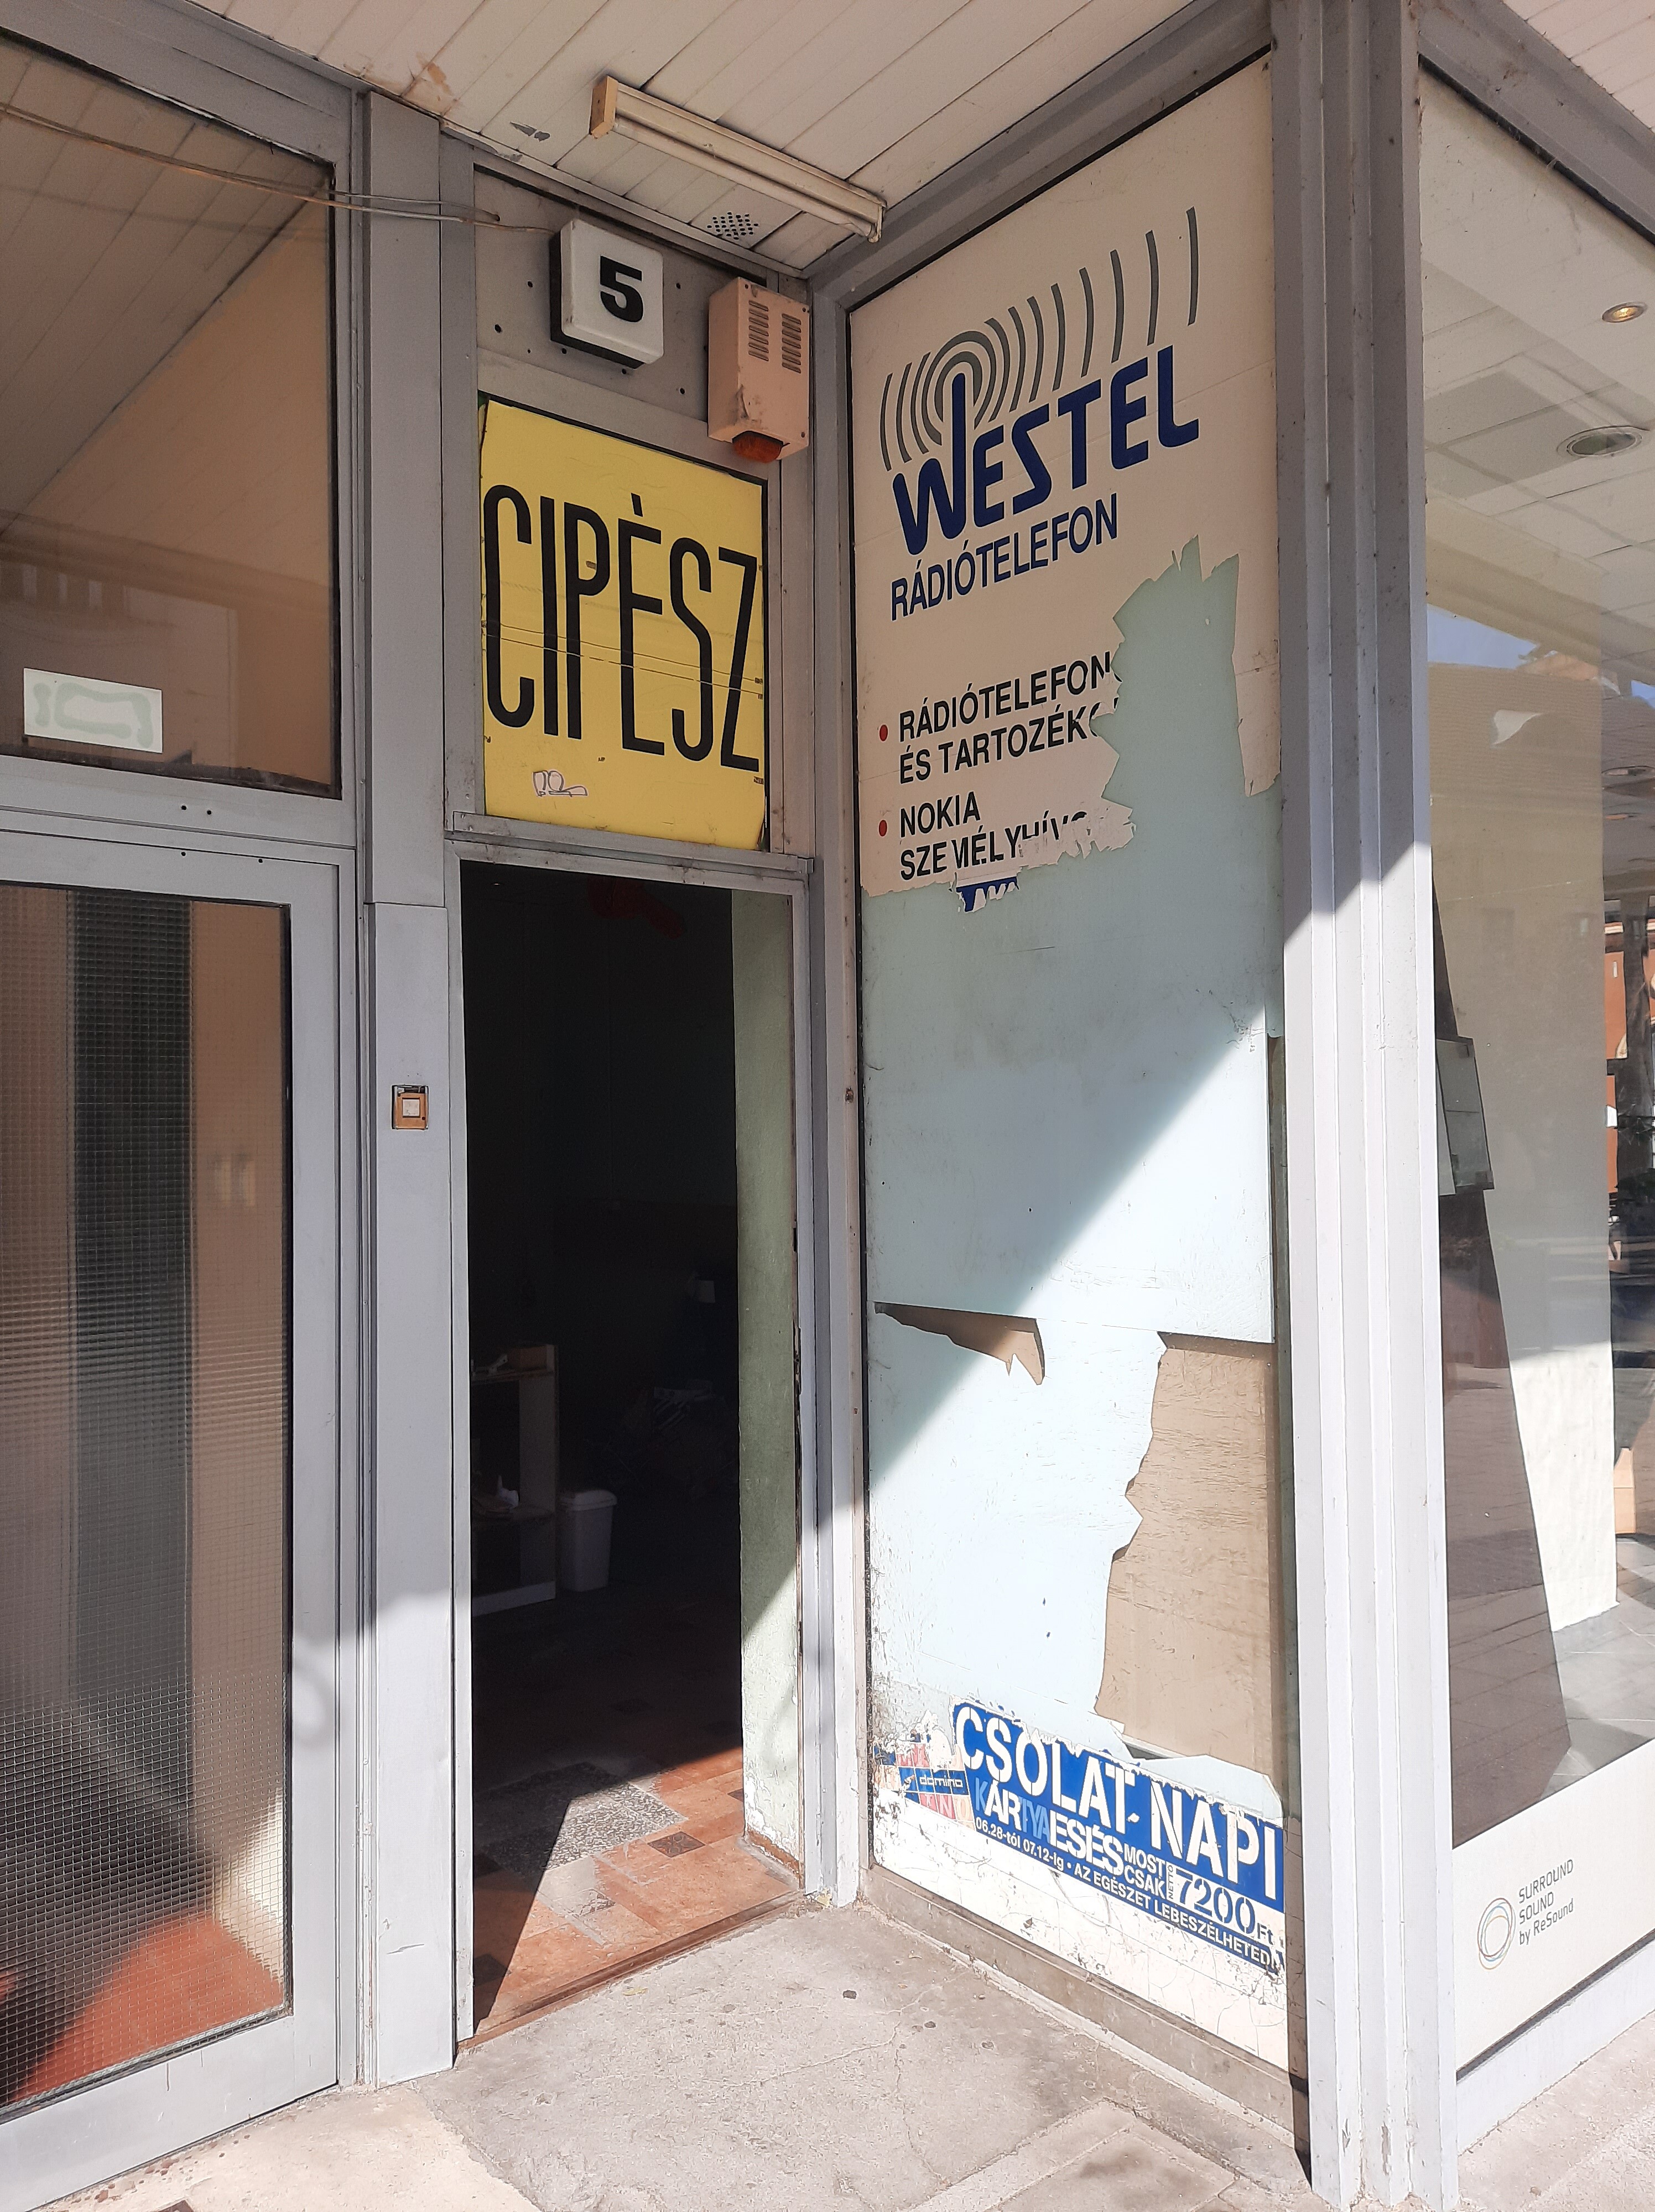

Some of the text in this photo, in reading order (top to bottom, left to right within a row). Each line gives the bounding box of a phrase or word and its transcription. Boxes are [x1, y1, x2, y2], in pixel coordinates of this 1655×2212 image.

[599, 256, 643, 323] 5
[892, 345, 1199, 555] WESTEL
[892, 493, 1118, 621] RÁDIÓTELEFON
[899, 651, 1122, 742] RÁDIÓTELEFON
[899, 745, 931, 784] ÉS
[900, 791, 981, 838] NOKIA
[919, 1773, 964, 1788] domino
[1124, 1843, 1165, 1879] MOST
[1124, 1865, 1165, 1900] CSAK
[1518, 1859, 1574, 1904] SURROUND
[1074, 1863, 1091, 1882] AZ
[1093, 1870, 1152, 1910] EGÉSZET
[1175, 1867, 1256, 1934] 7200
[1519, 1891, 1554, 1925] SOUND
[1519, 1898, 1574, 1945] by ReSound
